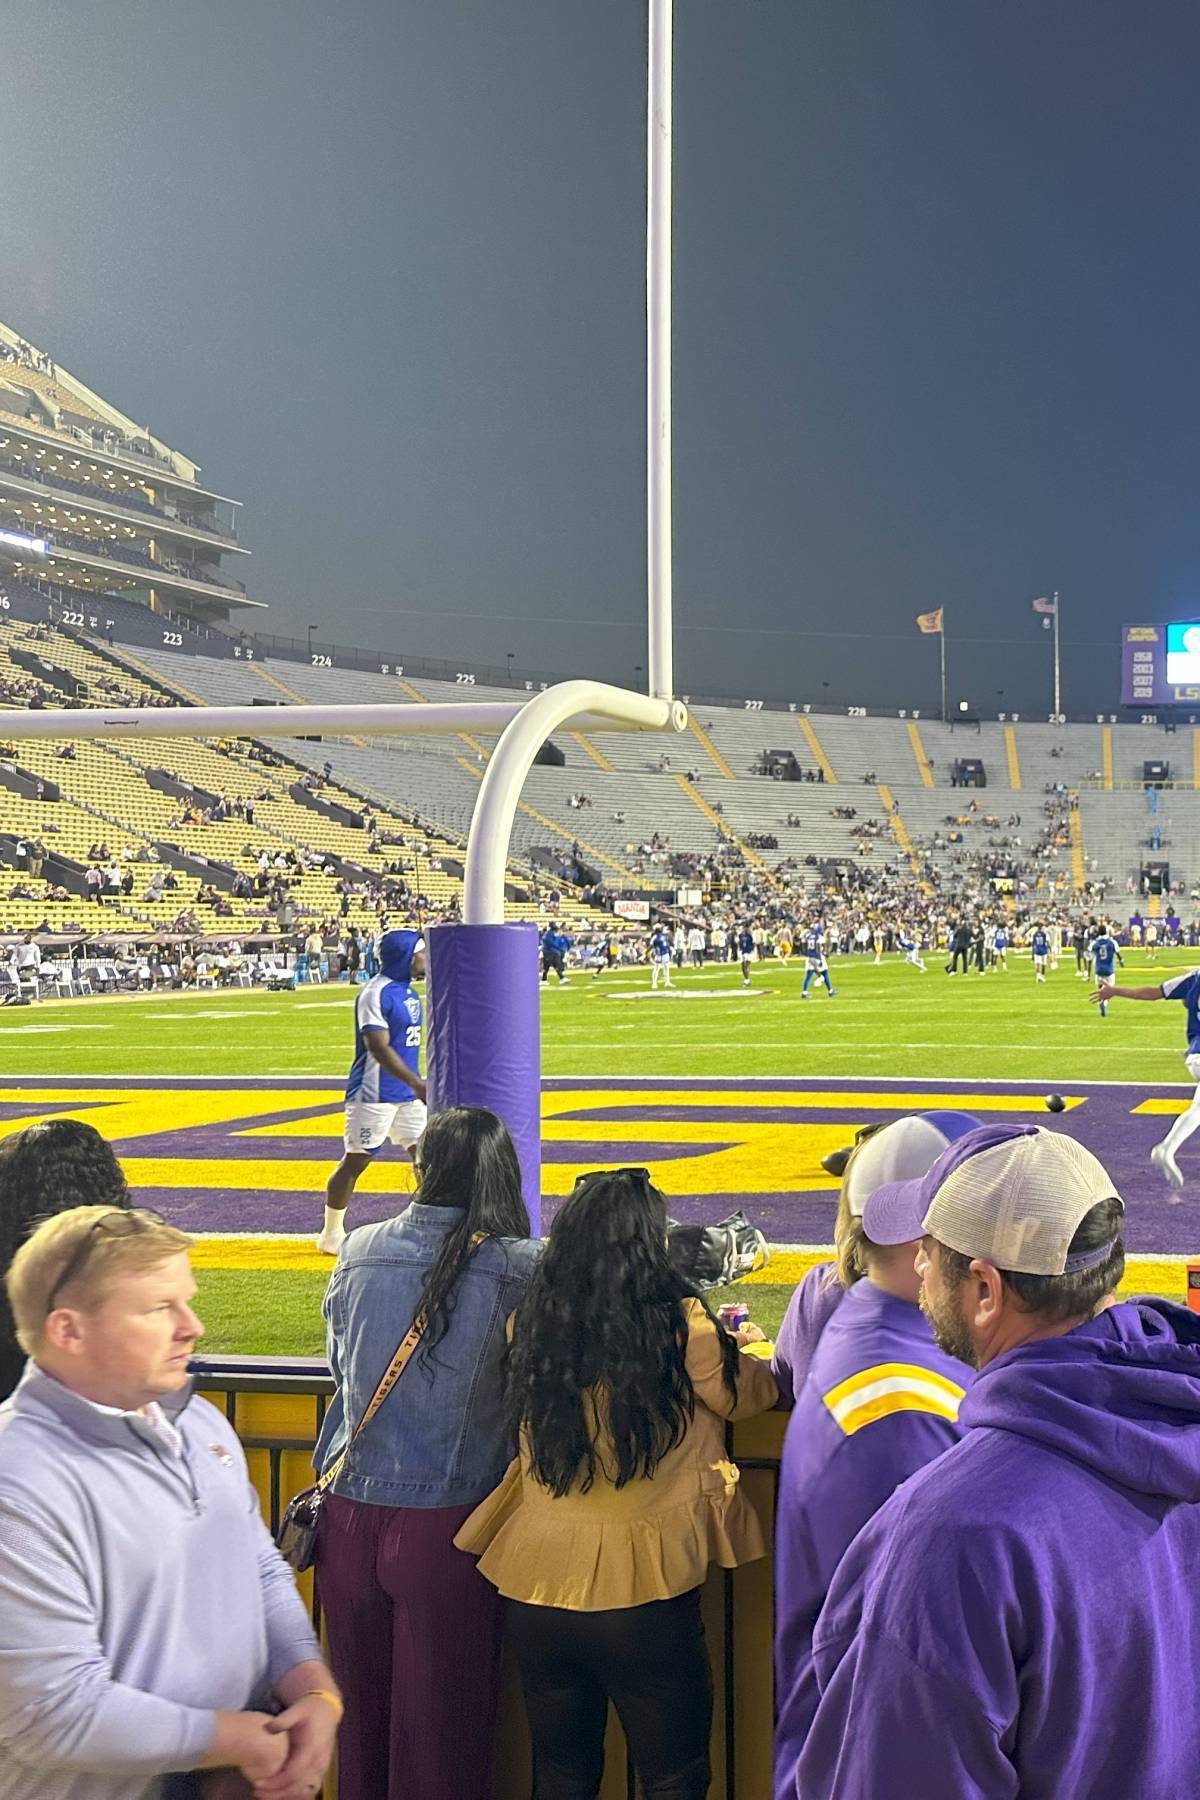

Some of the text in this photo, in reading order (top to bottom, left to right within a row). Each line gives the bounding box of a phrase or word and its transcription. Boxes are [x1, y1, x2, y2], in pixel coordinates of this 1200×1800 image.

[62, 611, 84, 626] 222
[163, 632, 183, 646] 223
[311, 654, 332, 667] 224
[456, 673, 476, 685] 225
[744, 700, 764, 710] 227
[848, 706, 867, 716] 228
[1141, 715, 1157, 724] 231
[1099, 948, 1108, 960] 9
[406, 1026, 421, 1047] 25
[371, 1359, 403, 1410] TIGERS
